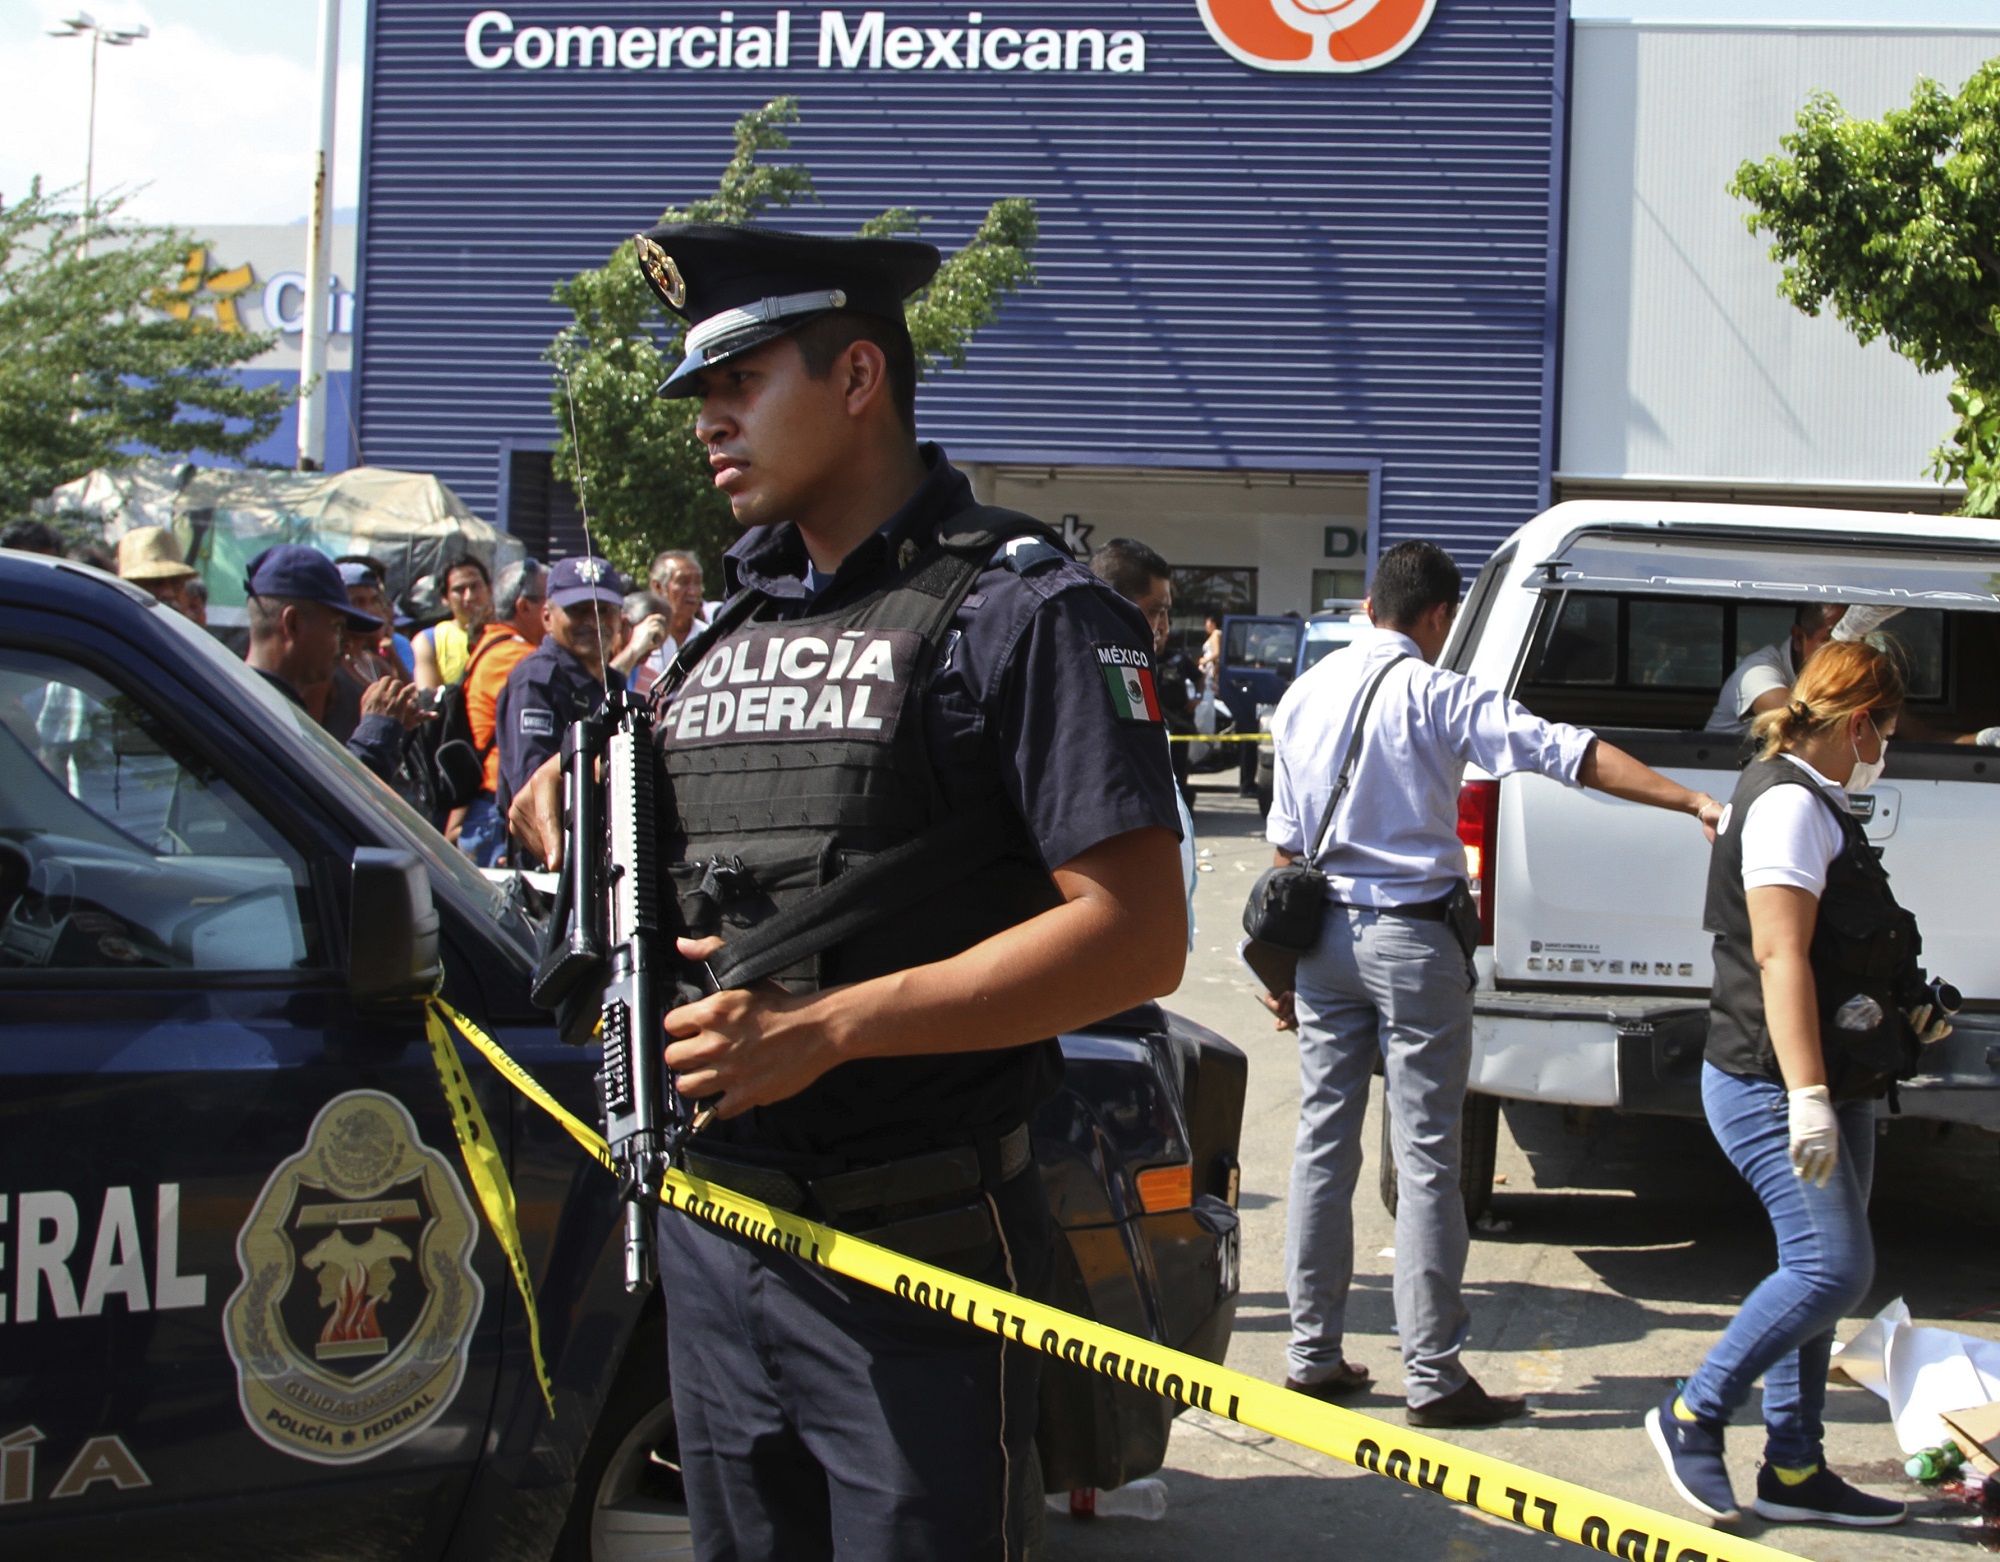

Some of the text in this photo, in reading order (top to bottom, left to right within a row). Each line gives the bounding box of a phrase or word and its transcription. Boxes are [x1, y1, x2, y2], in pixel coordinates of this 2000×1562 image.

[465, 10, 1146, 72] Comercial Mexicana
[1324, 526, 1367, 558] D
[1097, 645, 1149, 667] MÉXICO
[660, 684, 882, 740] FEDERAL
[1527, 957, 1694, 977] CHEYENNE
[266, 1393, 435, 1446] POLICÍA FEDERAL
